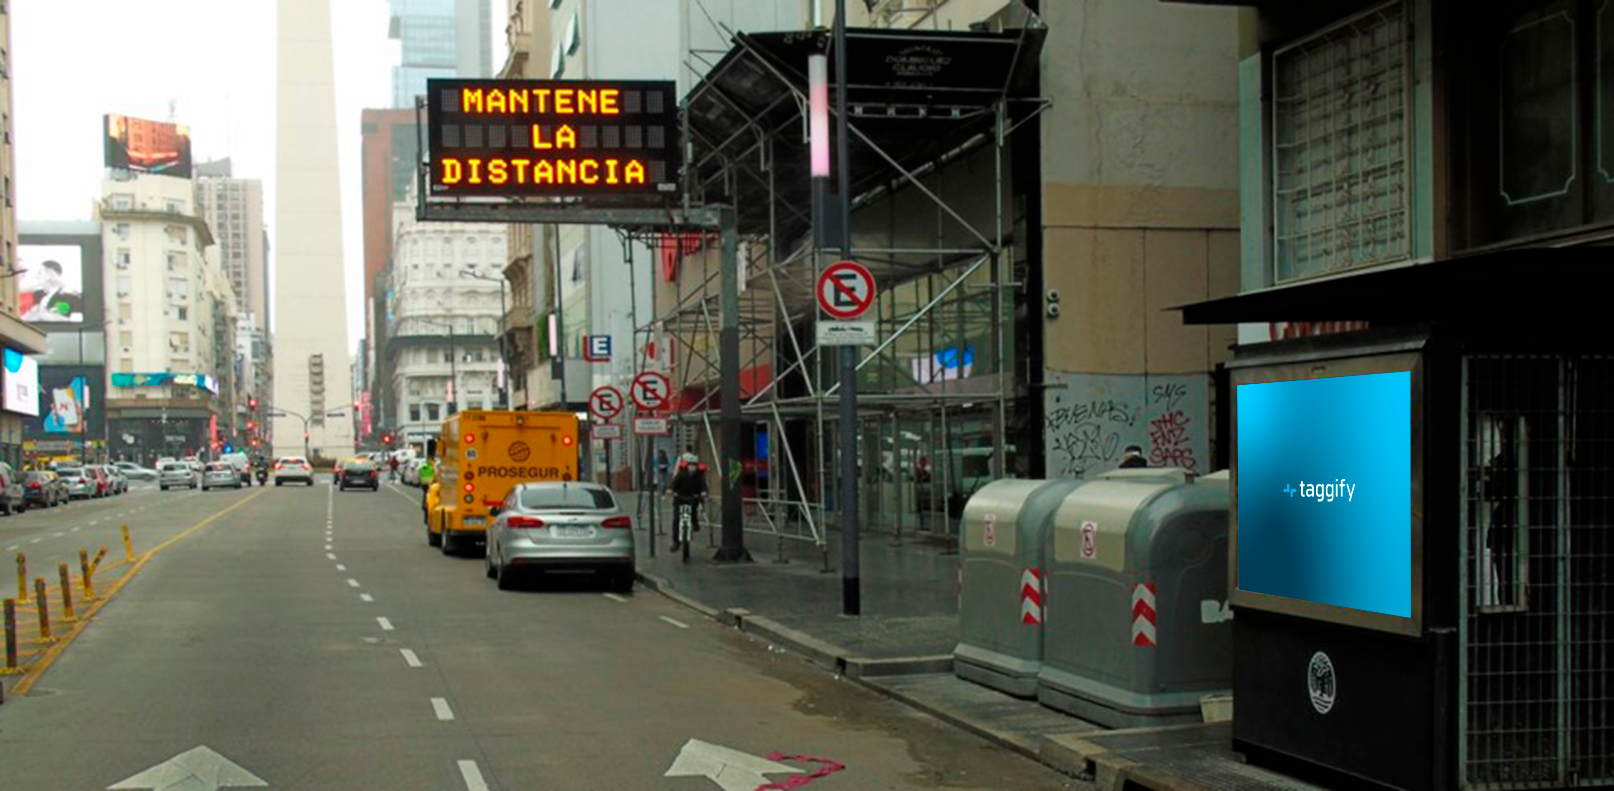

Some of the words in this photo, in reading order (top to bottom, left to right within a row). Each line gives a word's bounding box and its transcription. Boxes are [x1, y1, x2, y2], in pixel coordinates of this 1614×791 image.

[462, 88, 620, 114] MANTENE
[532, 124, 576, 149] LA
[441, 158, 645, 184] DISTANCIA
[592, 338, 607, 355] E
[478, 466, 560, 479] PROSEGUR
[1299, 478, 1356, 502] taggify
